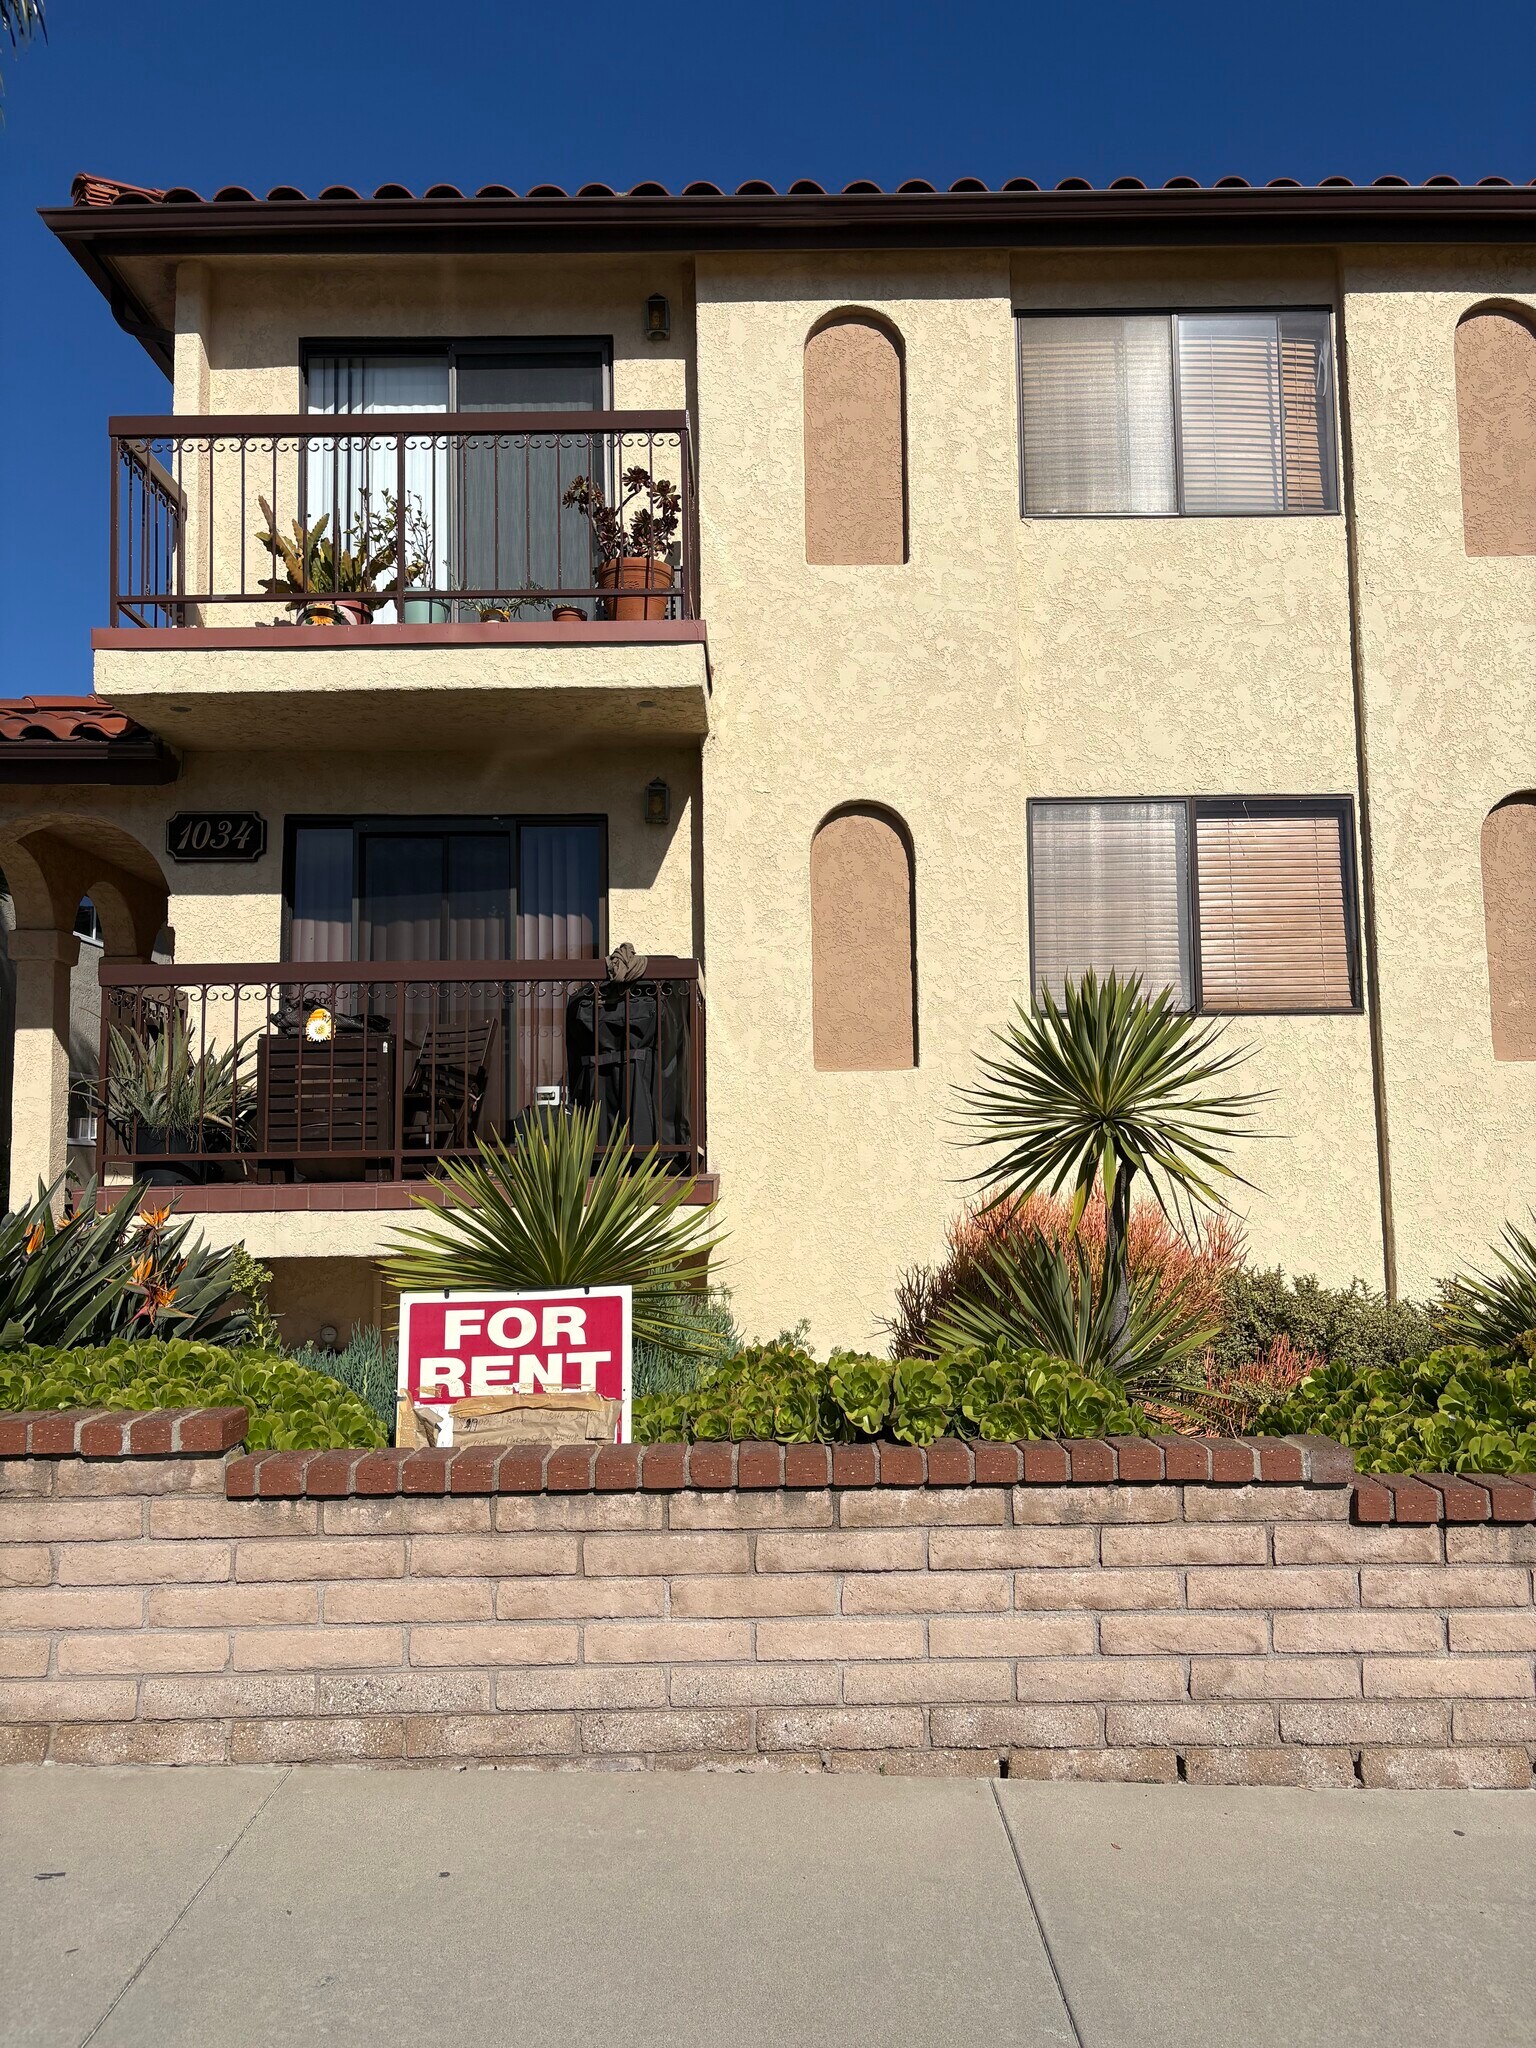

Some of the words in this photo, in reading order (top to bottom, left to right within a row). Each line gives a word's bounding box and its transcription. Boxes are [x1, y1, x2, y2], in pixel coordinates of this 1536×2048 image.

[177, 820, 254, 850] 1034
[444, 1306, 587, 1350] FOR
[419, 1351, 612, 1399] RENT
